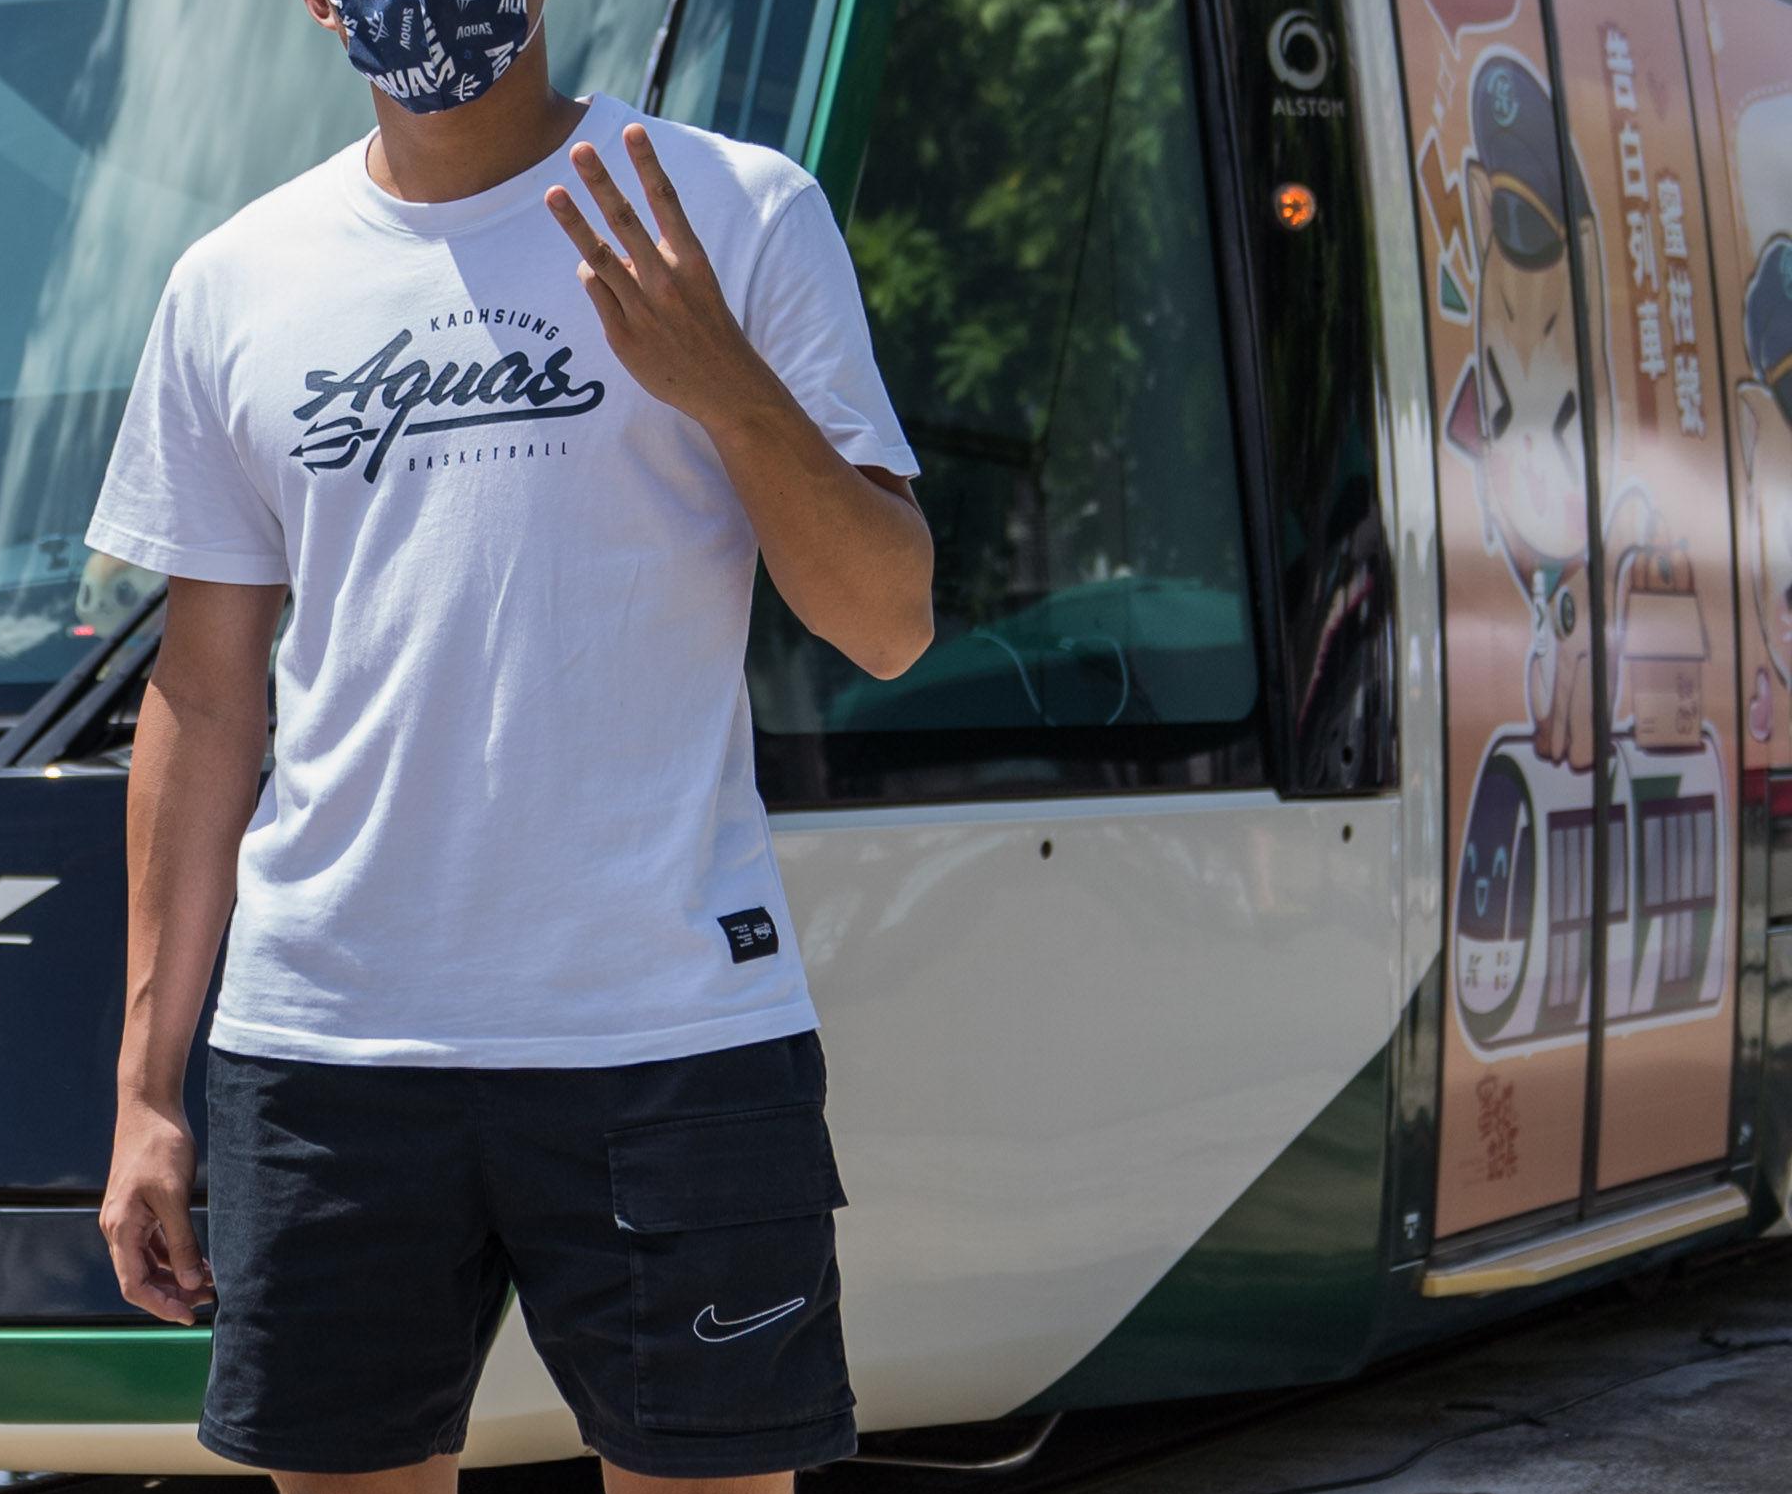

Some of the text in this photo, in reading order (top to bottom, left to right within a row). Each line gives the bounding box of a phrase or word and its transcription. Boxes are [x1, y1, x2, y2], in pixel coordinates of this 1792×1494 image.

[399, 8, 414, 50] AQUAS
[456, 21, 493, 40] AQUAS
[1272, 97, 1345, 117] ALSTOM
[1606, 28, 1667, 381] 告白列車
[430, 308, 560, 341] KAOHSIUNG
[293, 329, 605, 484] Aquas
[409, 442, 568, 472] BASKETBALL
